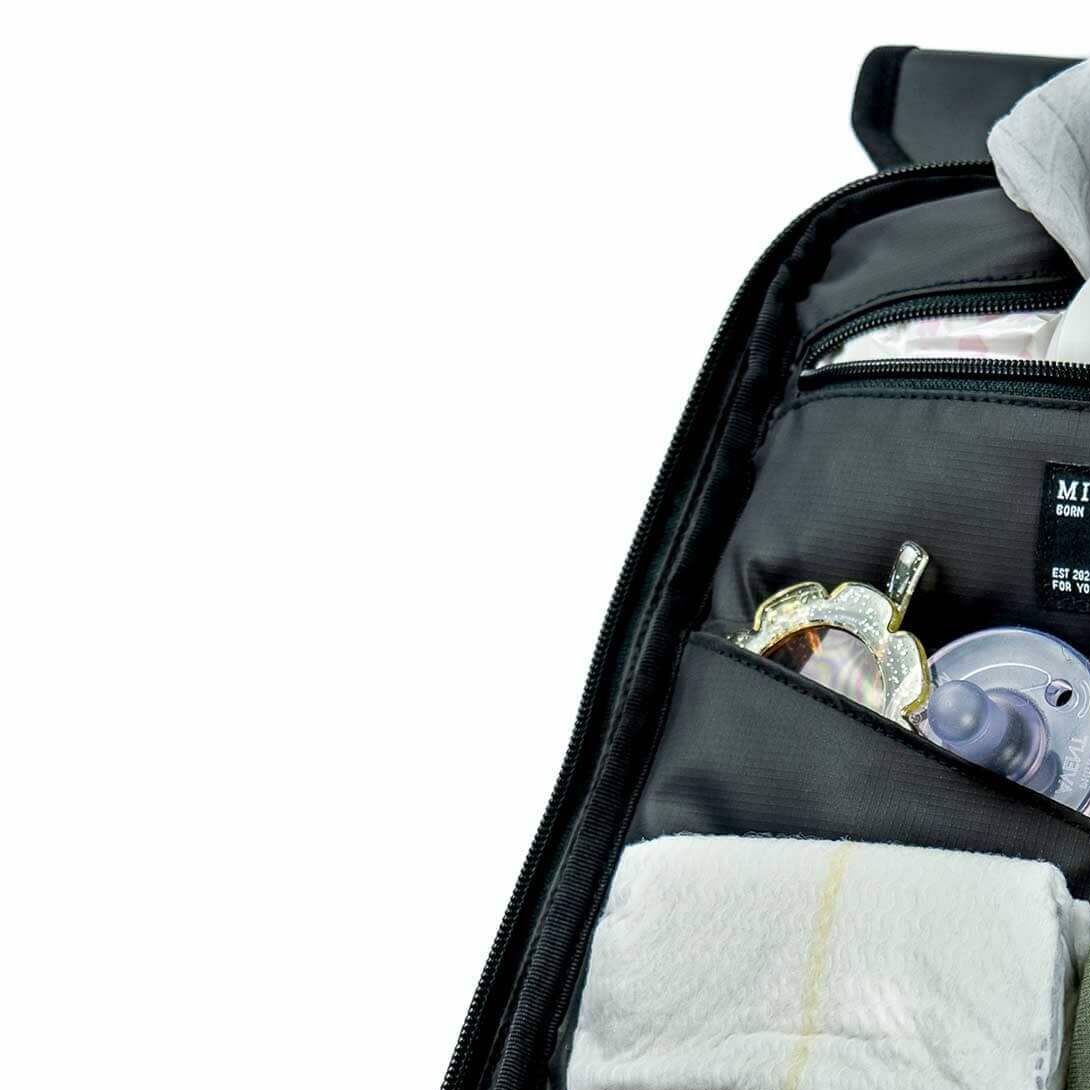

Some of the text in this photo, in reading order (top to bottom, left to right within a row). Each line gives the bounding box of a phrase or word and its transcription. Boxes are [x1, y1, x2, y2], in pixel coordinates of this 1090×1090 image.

[1056, 504, 1085, 518] BORN
[1052, 567, 1070, 579] EST
[1052, 580, 1072, 592] FOR
